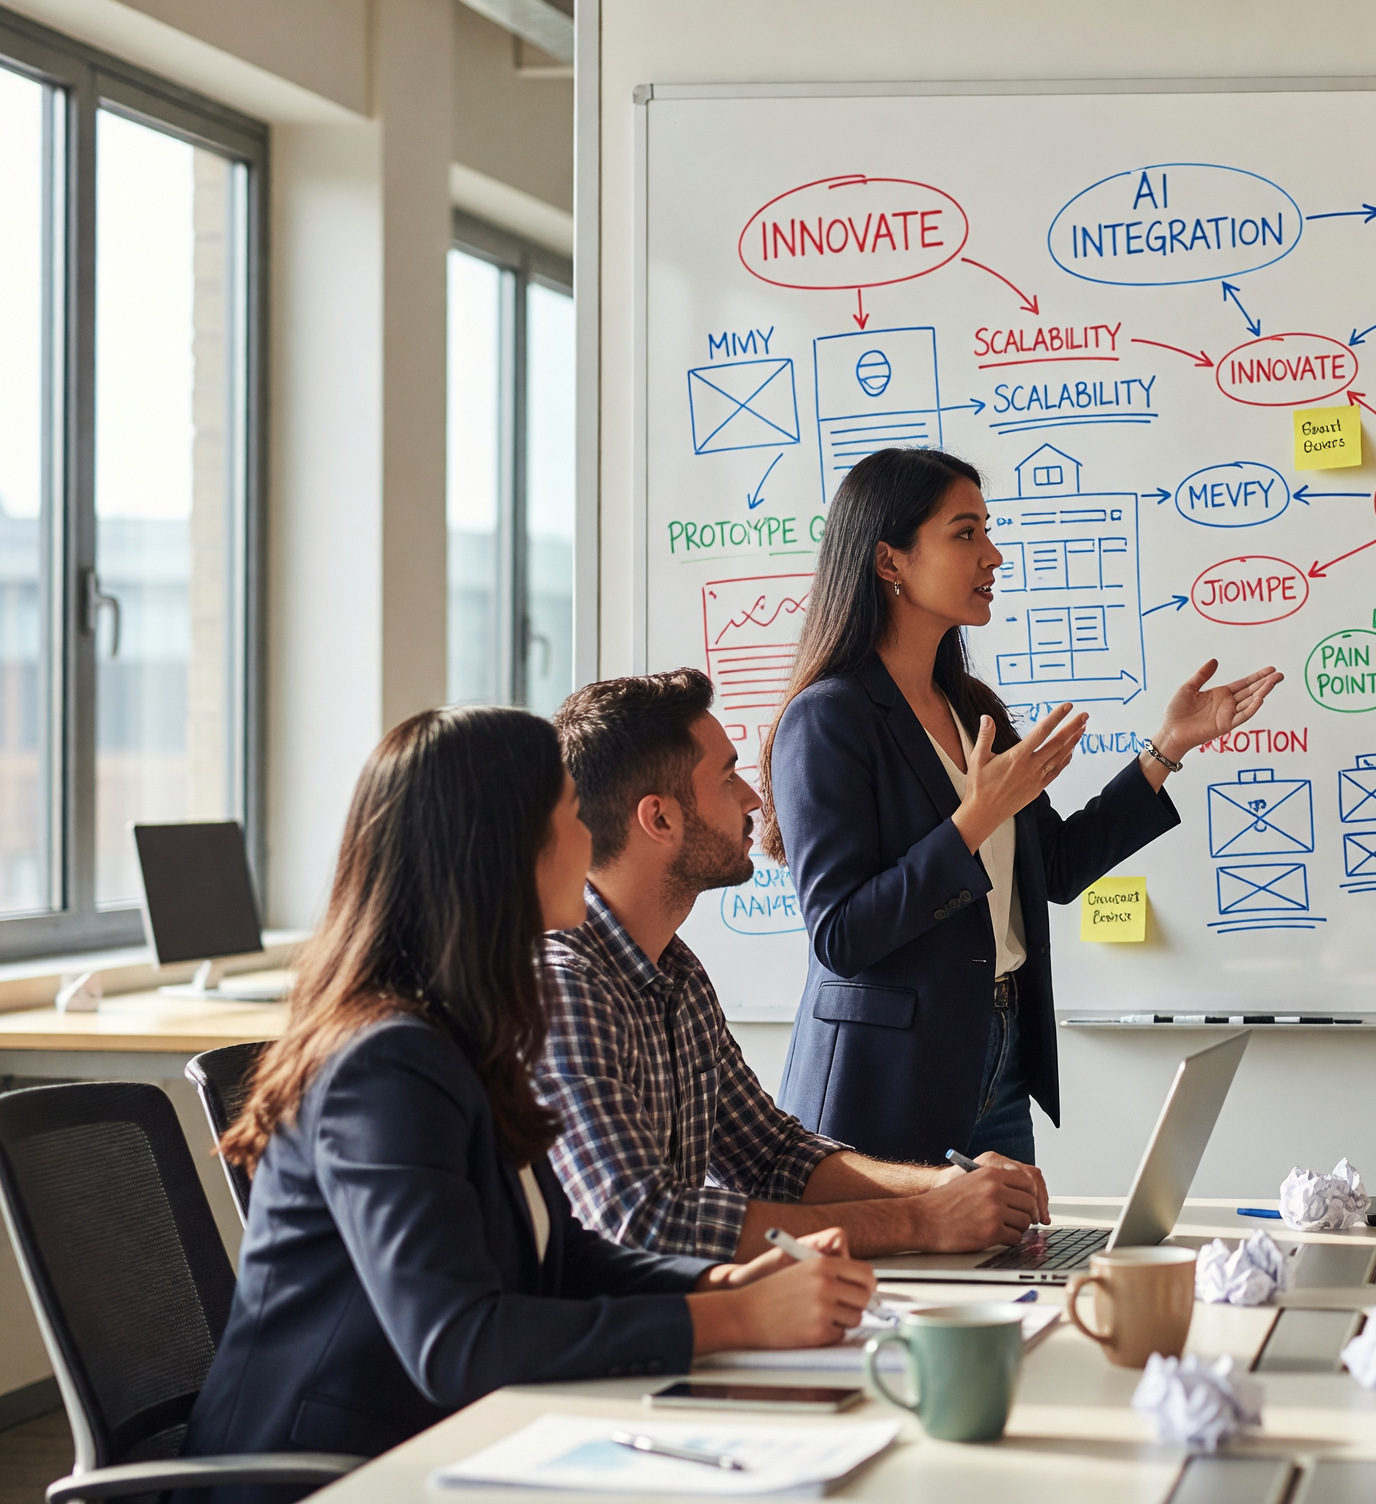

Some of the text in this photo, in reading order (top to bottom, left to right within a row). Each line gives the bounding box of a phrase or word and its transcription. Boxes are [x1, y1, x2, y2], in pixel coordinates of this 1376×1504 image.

[1134, 172, 1168, 210] AI
[762, 210, 944, 262] INNOVATE
[1073, 214, 1283, 259] INTEGRATION
[974, 323, 1122, 357] SCALABILITY
[1231, 354, 1346, 385] INNOVATE
[994, 376, 1156, 414] SCALABILITY
[1188, 478, 1275, 510] MEVFY
[1321, 645, 1370, 669] PAIN
